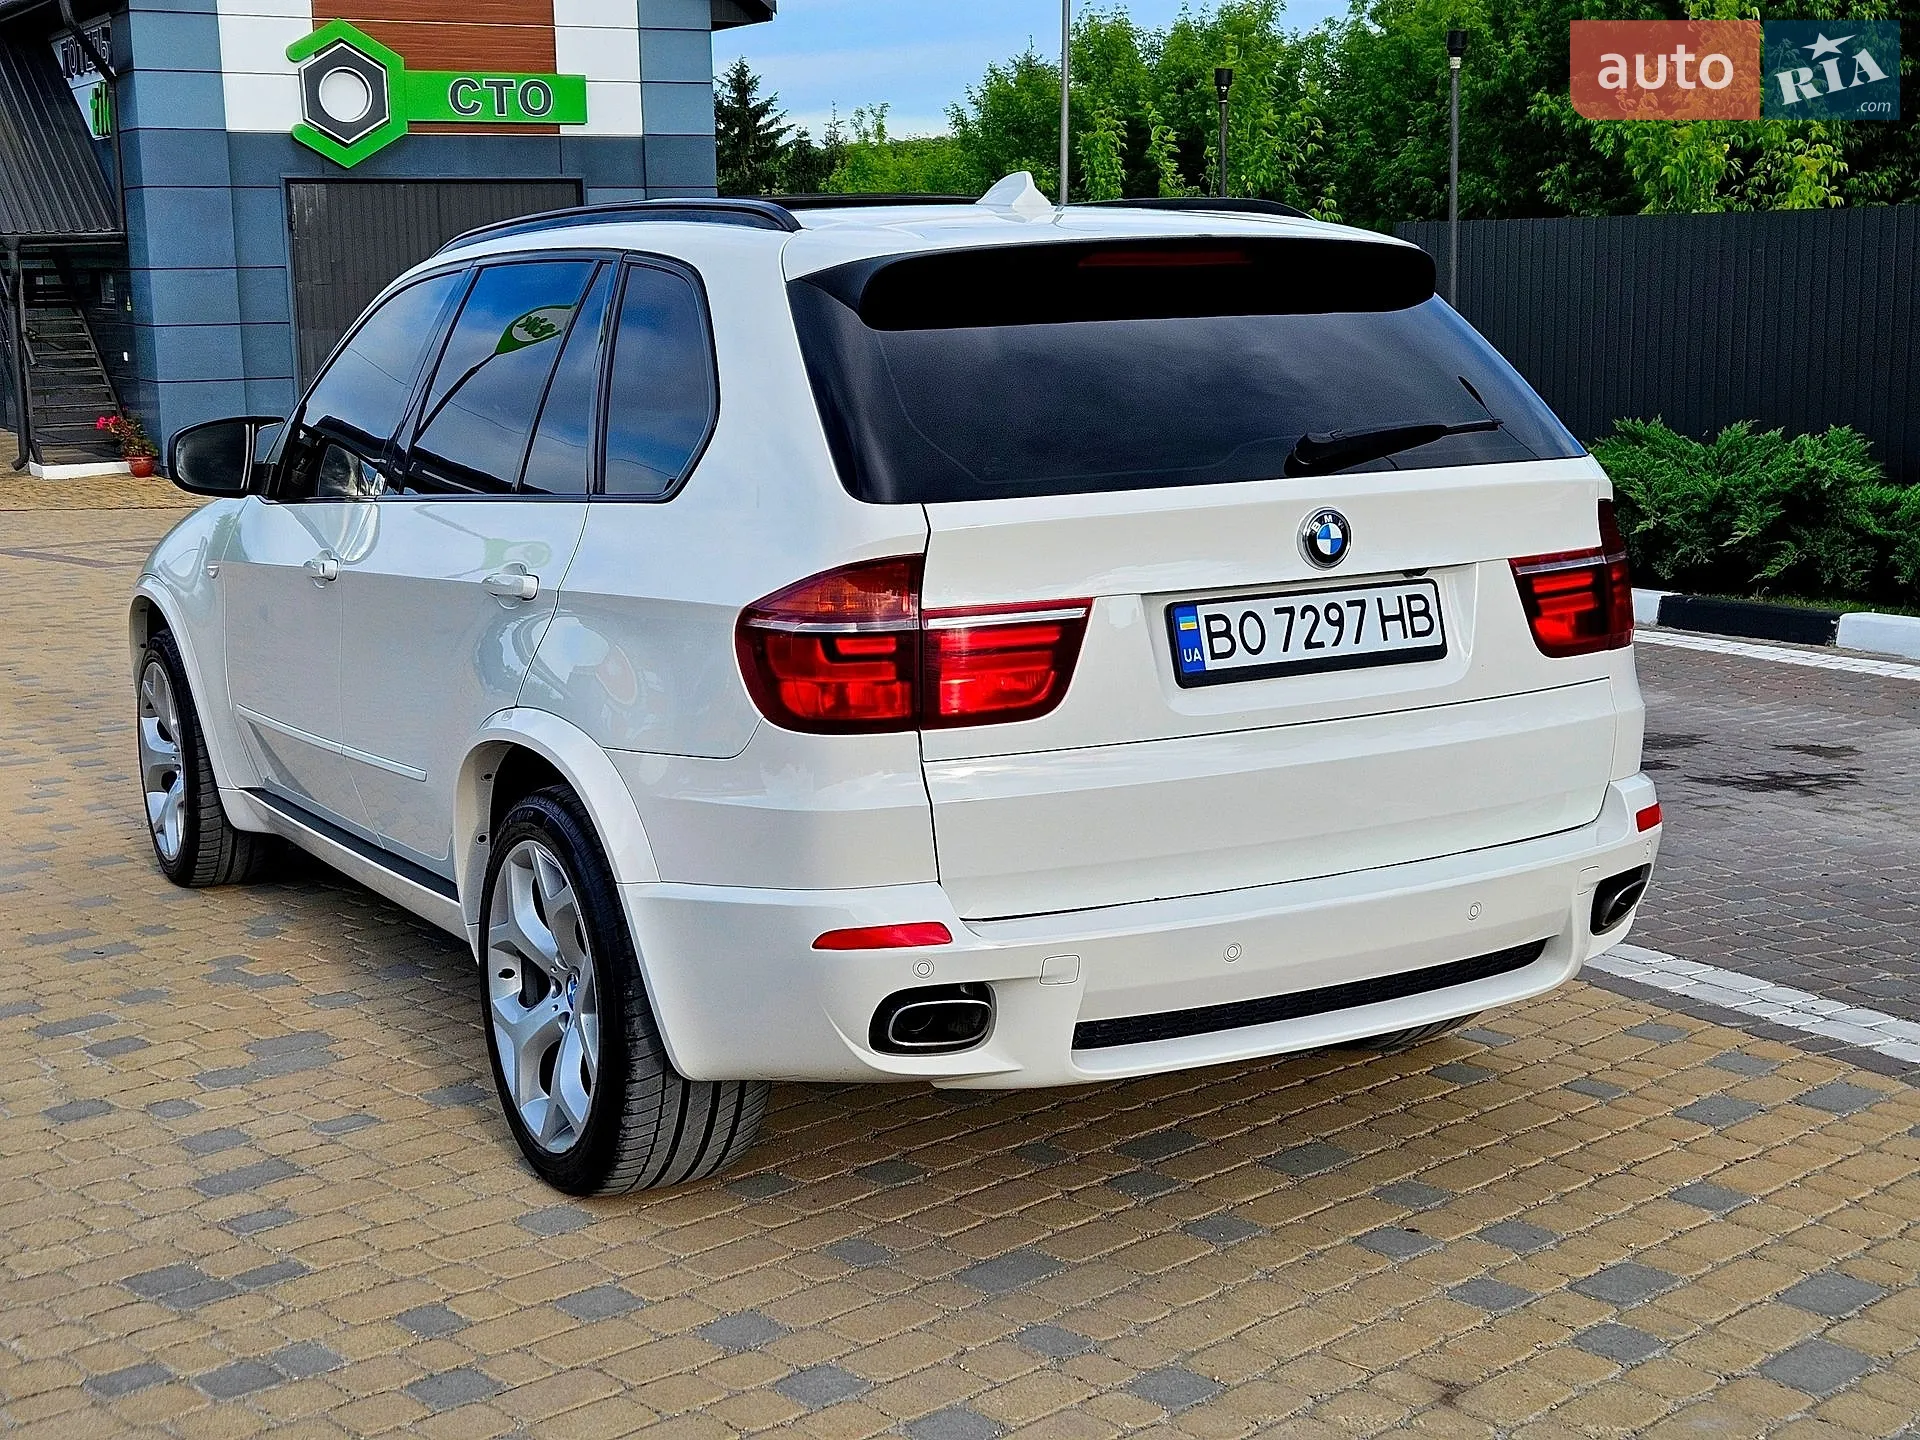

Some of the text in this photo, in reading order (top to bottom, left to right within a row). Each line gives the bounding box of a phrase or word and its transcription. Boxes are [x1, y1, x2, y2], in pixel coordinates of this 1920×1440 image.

[449, 77, 553, 116] СТО
[1204, 593, 1435, 660] BO 7297 HB
[1183, 650, 1203, 663] UA
